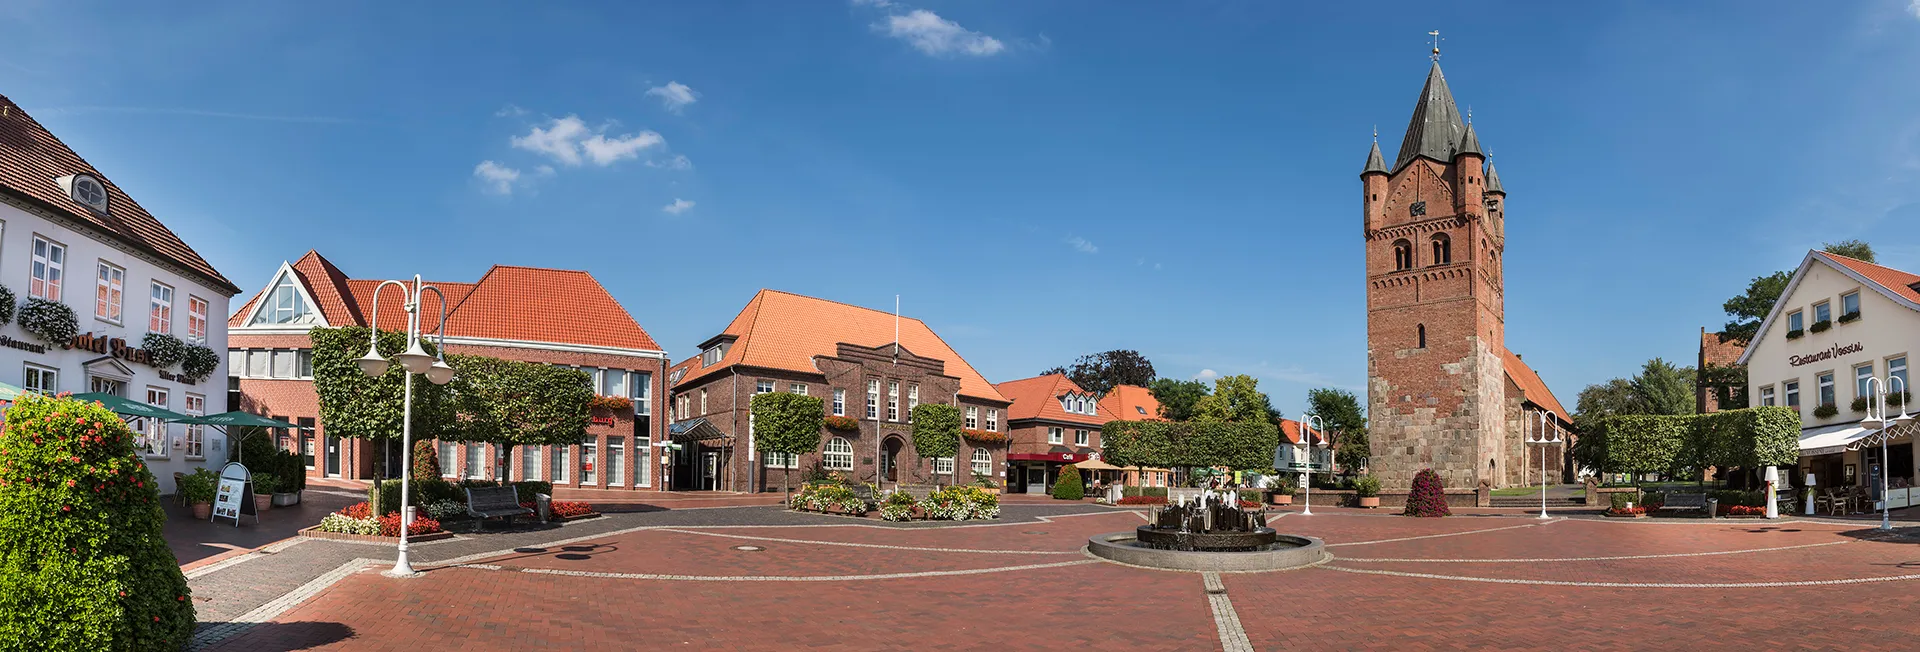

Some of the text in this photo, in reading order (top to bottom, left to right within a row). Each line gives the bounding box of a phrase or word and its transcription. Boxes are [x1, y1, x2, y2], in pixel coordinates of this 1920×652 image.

[0, 334, 46, 355] staurant
[63, 331, 107, 354] otel
[1789, 348, 1831, 367] Restaurant
[592, 416, 613, 425] burg
